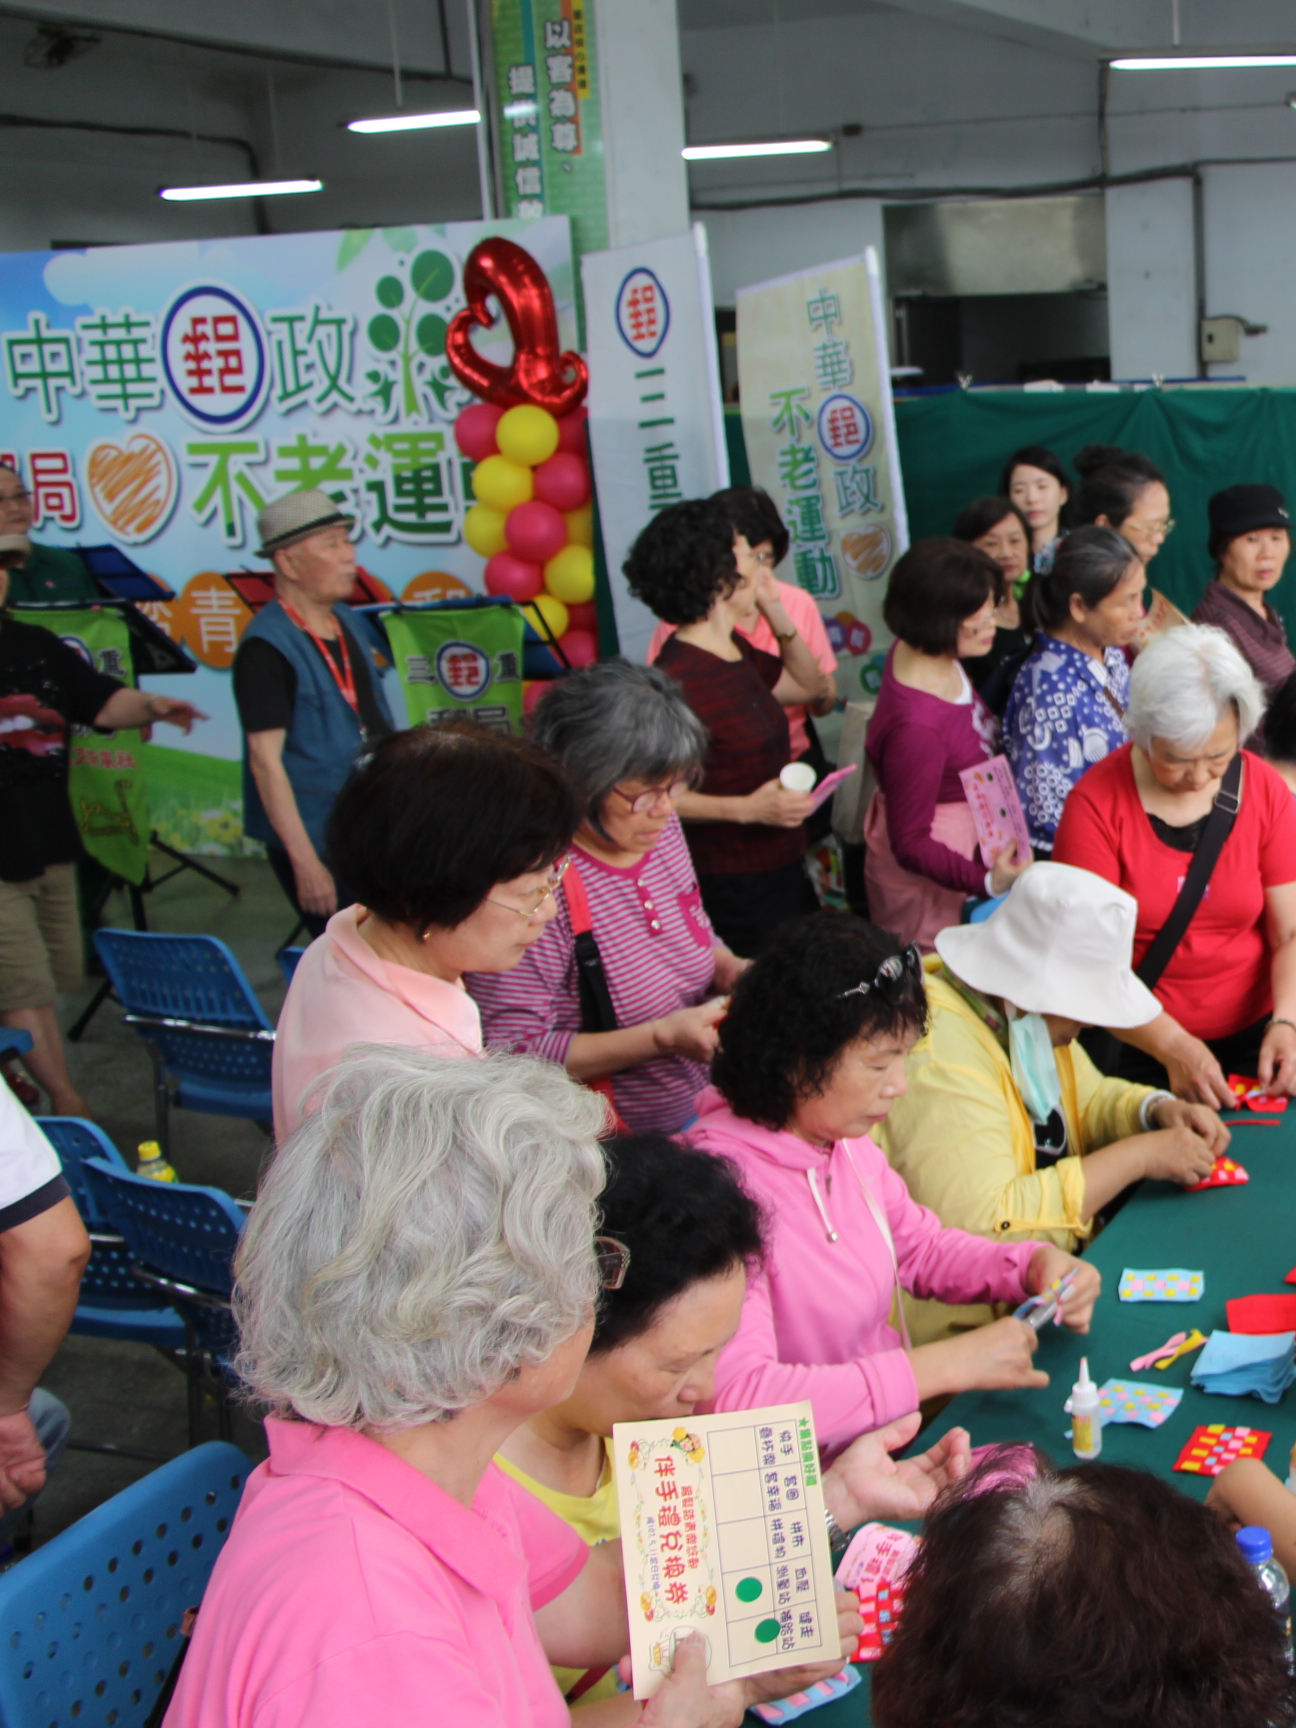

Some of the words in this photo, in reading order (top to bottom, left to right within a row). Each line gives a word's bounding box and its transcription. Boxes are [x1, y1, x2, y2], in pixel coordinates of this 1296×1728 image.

[0, 452, 77, 524] 局
[652, 1455, 689, 1605] 伴手禮兌換券
